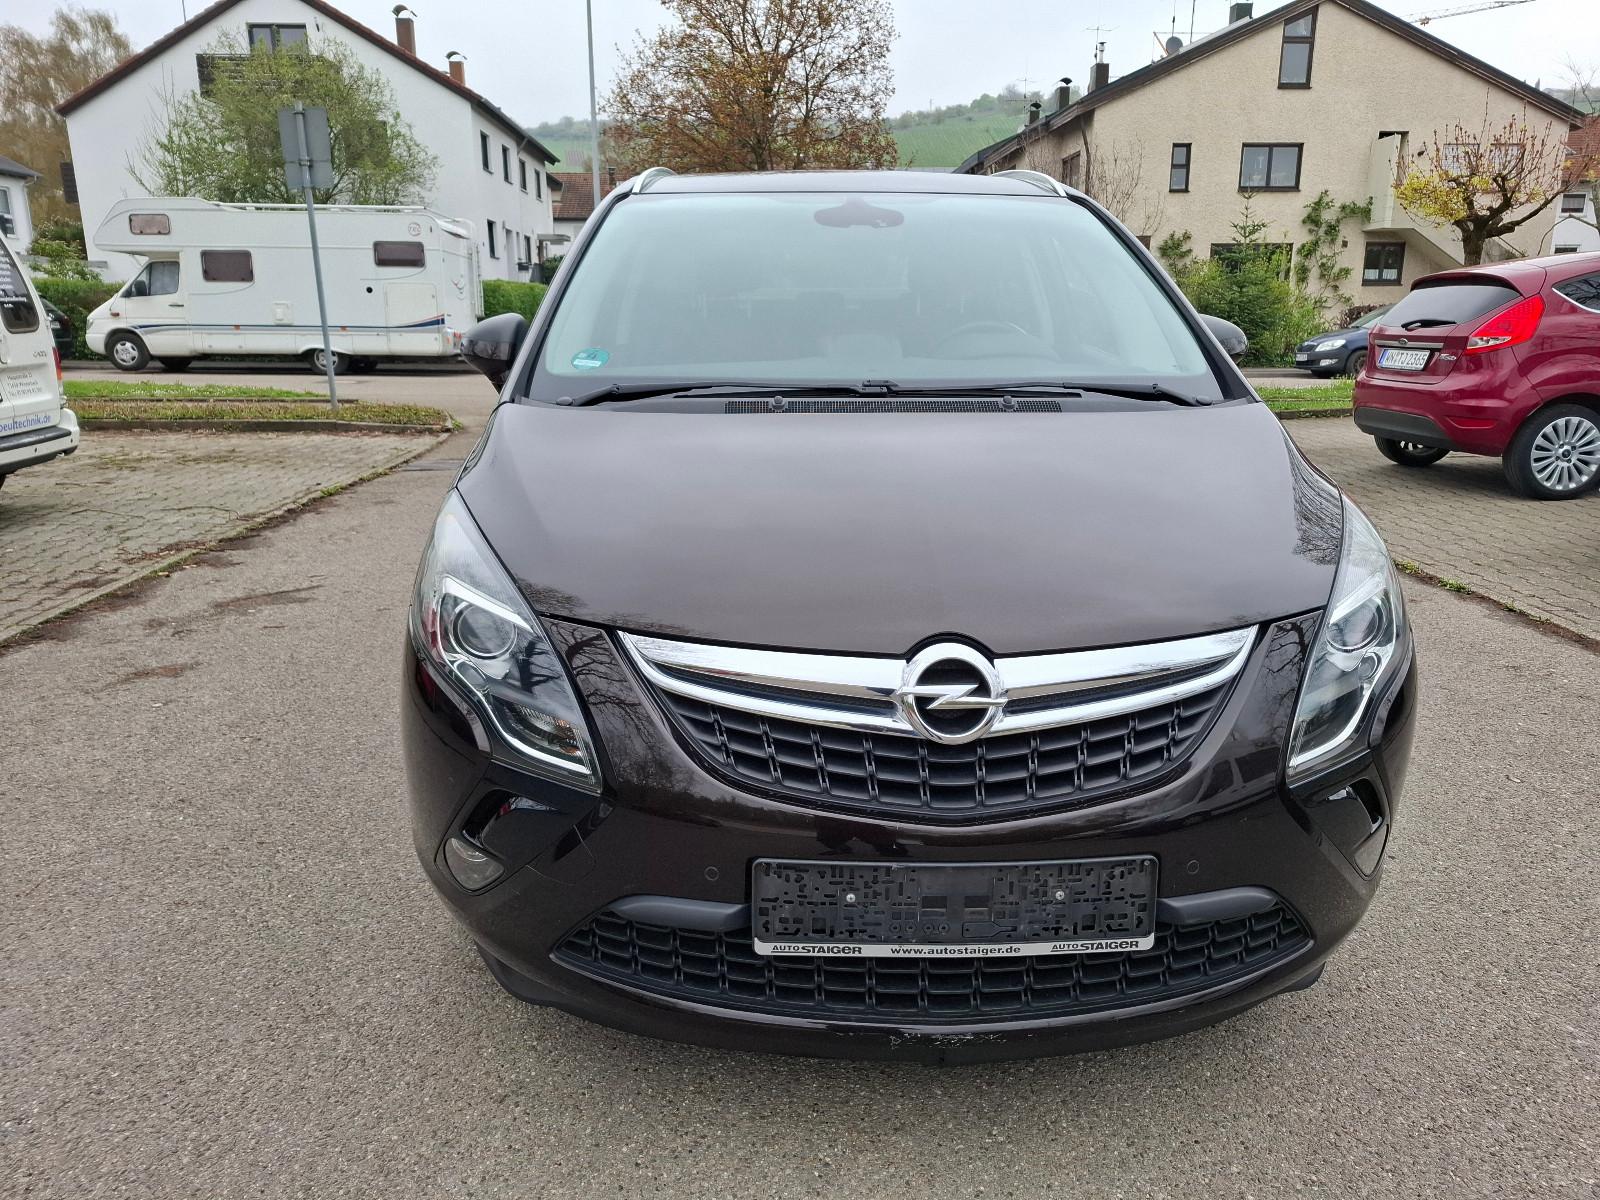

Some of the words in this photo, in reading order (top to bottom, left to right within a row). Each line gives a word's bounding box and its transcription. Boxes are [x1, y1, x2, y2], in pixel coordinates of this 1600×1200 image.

[772, 944, 800, 952] AUTO
[801, 945, 863, 955] STAIGER
[890, 945, 1021, 956] www.autostaiger.de
[1052, 942, 1079, 950] AUTO
[1080, 940, 1140, 951] STAIGER
